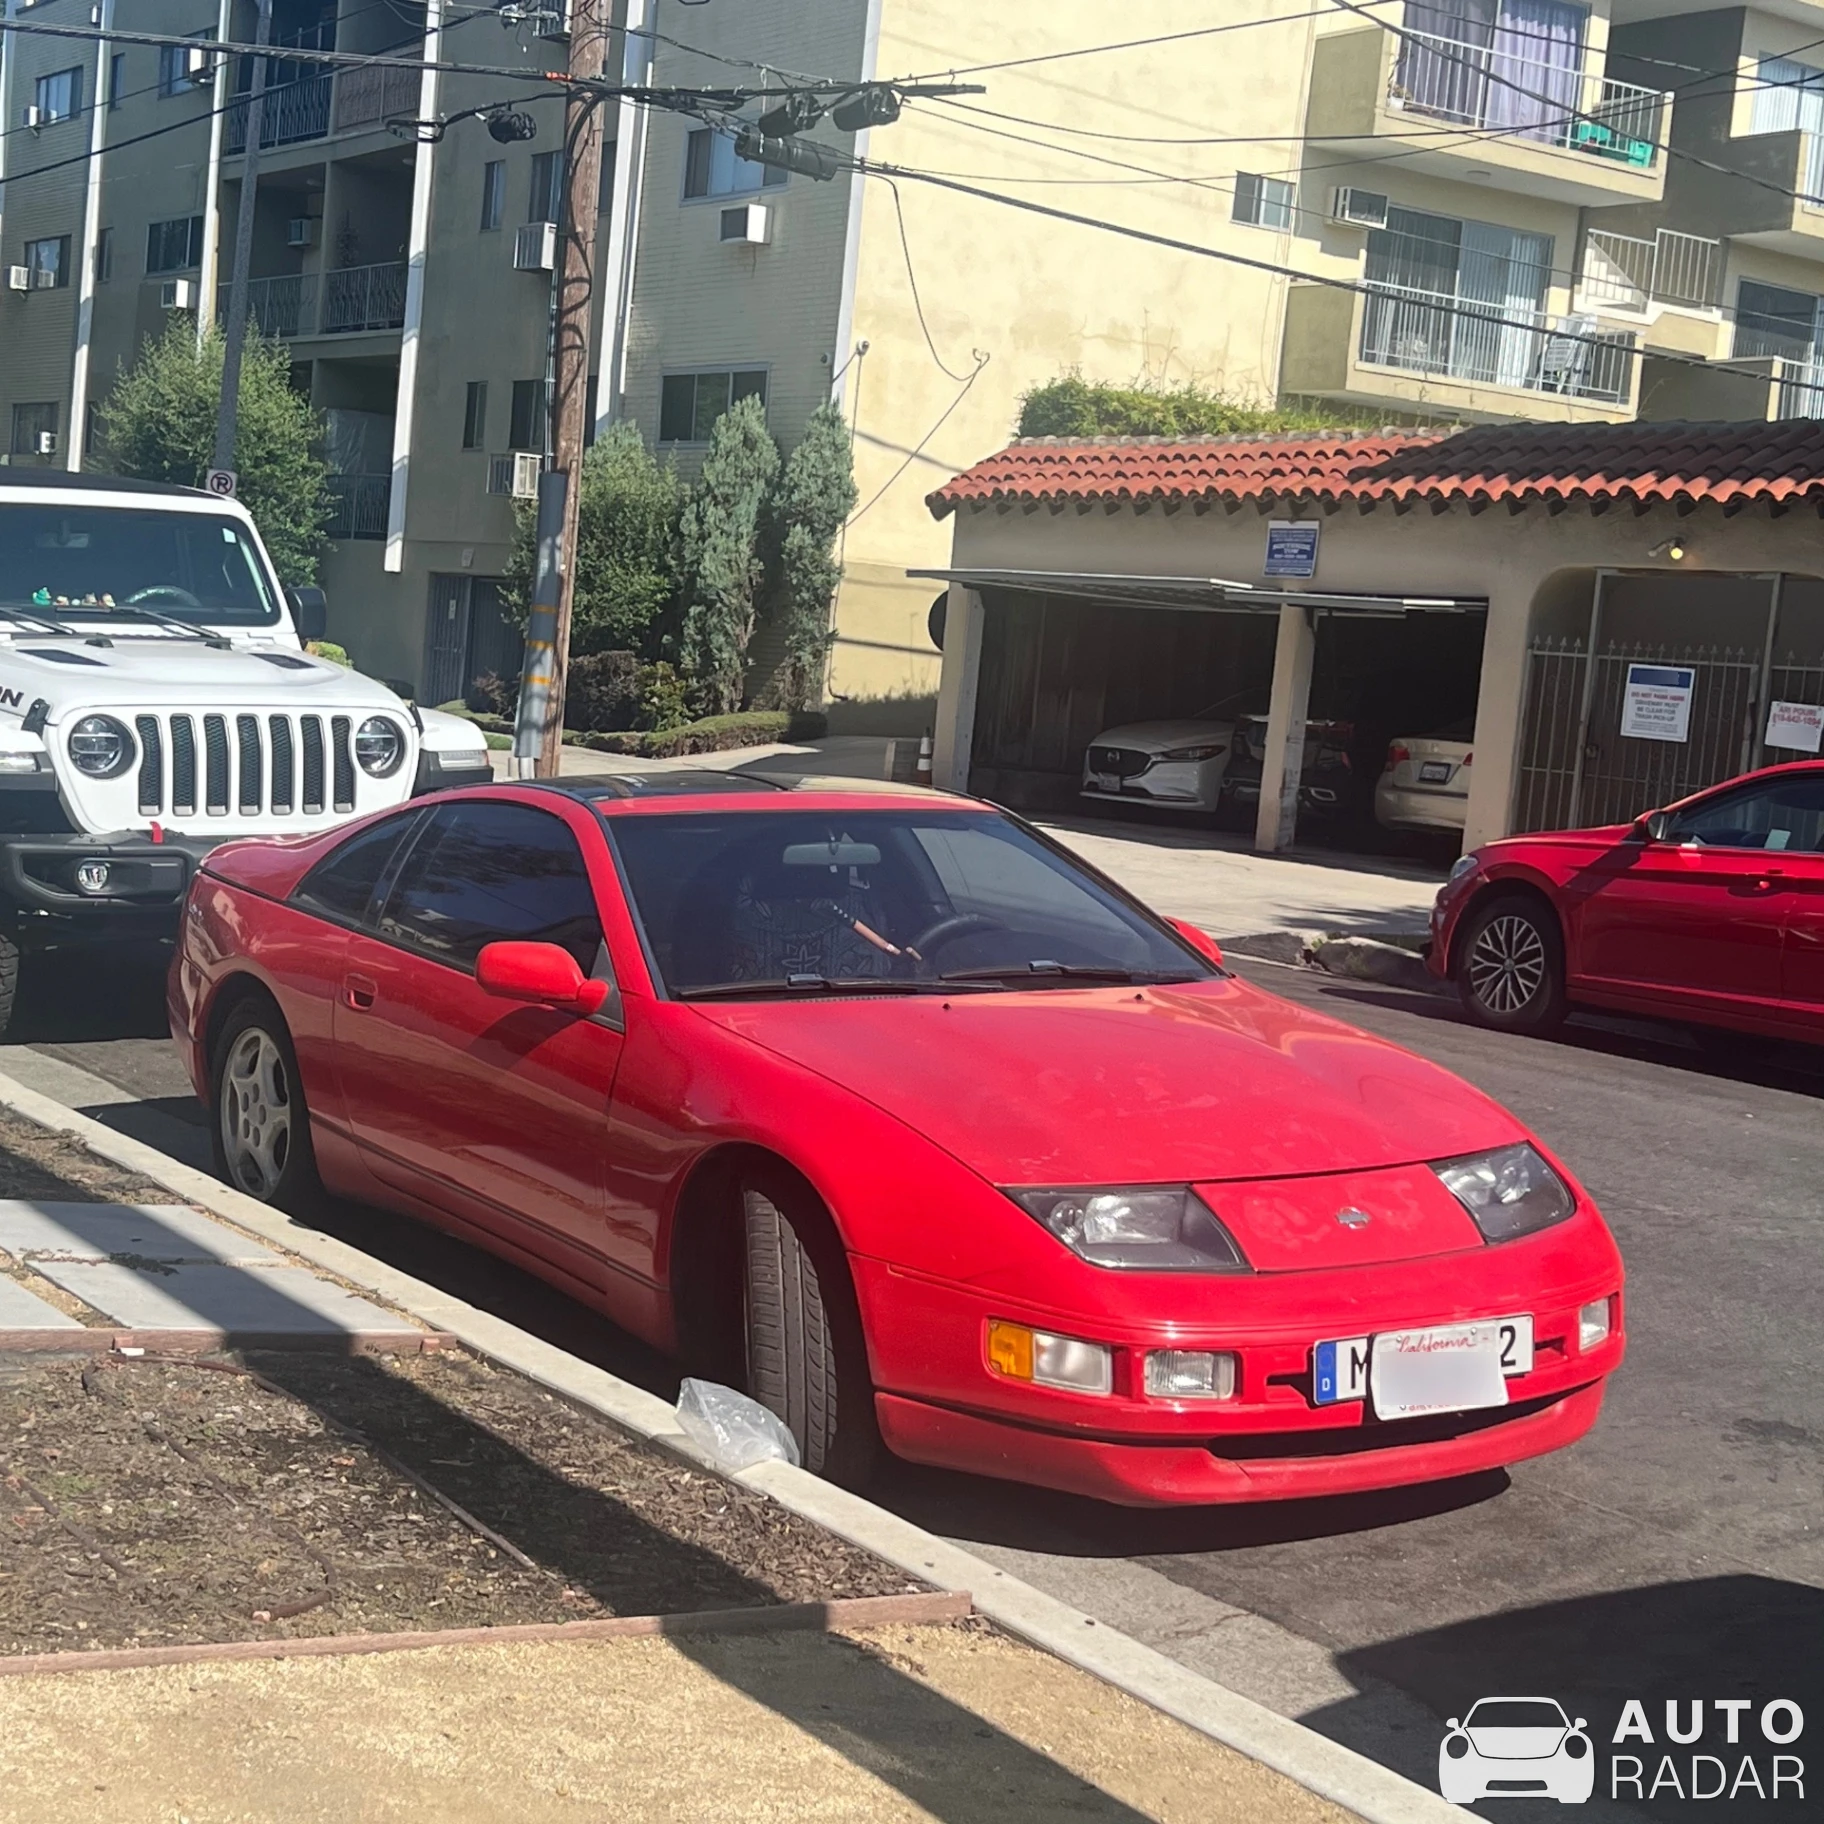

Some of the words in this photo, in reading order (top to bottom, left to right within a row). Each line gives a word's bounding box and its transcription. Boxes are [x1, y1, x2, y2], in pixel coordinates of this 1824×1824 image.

[0, 686, 24, 707] N
[1398, 1334, 1477, 1352] California
[1500, 1325, 1516, 1368] 2
[1321, 1377, 1331, 1392] D
